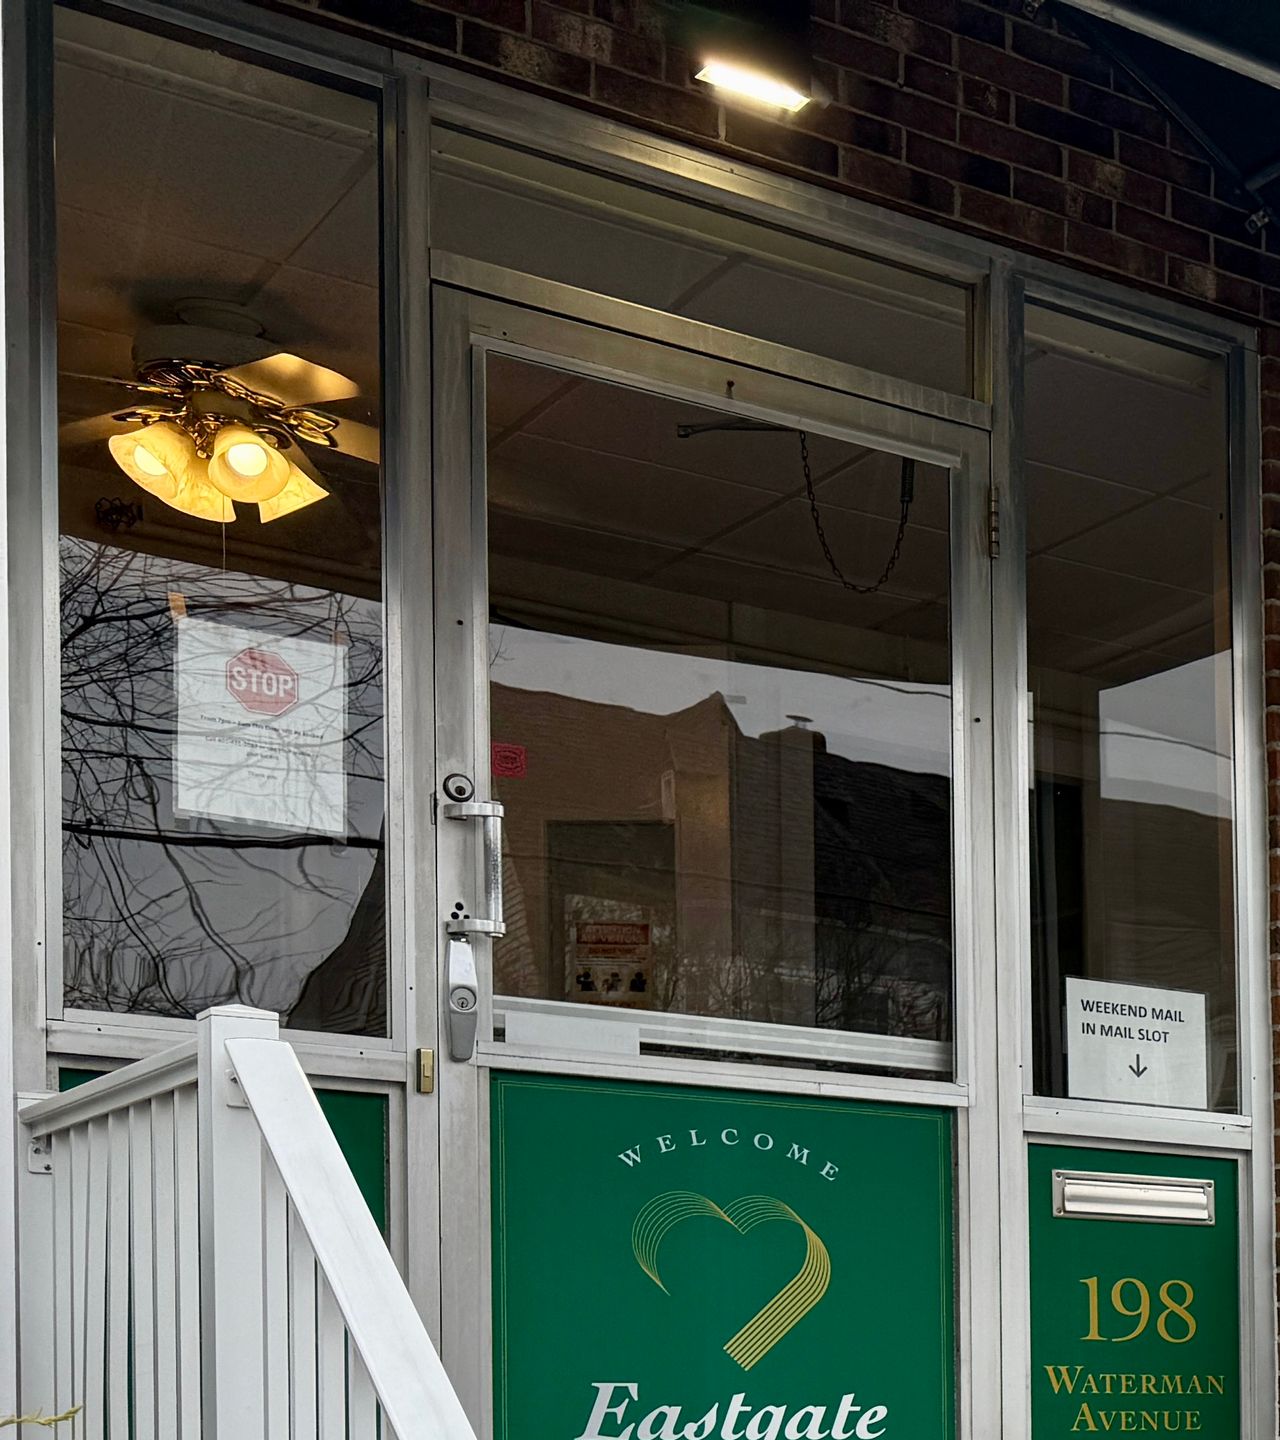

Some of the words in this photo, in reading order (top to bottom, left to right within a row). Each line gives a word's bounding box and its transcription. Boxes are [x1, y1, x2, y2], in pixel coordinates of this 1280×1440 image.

[231, 666, 294, 697] STOP
[1080, 998, 1148, 1020] WEEKEND
[1151, 1003, 1185, 1023] MAIL
[1081, 1021, 1096, 1037] IN
[1099, 1023, 1135, 1040] MAIL
[1137, 1026, 1170, 1044] SLOT
[618, 1128, 839, 1181] WELCOME
[1079, 1276, 1196, 1344] 198
